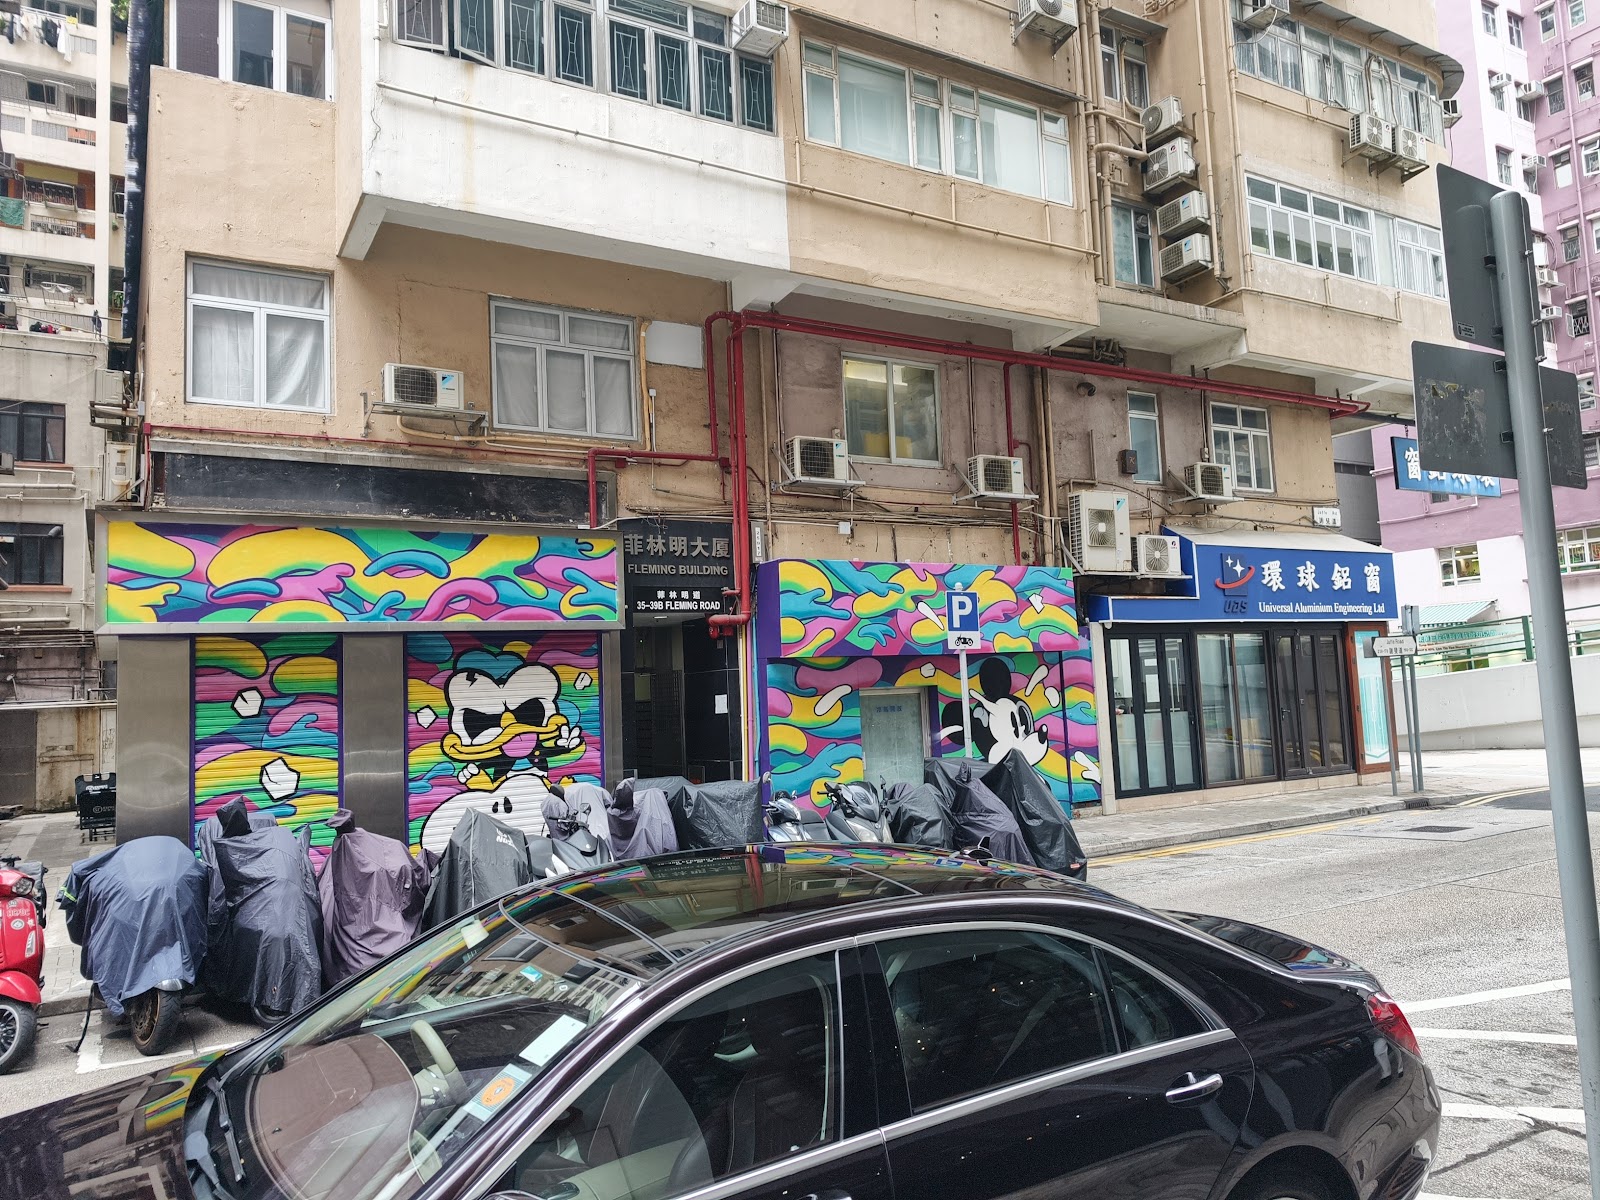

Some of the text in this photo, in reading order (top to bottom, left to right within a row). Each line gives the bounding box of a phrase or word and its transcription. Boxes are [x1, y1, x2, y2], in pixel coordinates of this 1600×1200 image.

[624, 534, 730, 558] 菲林明大厦
[628, 564, 728, 575] FLEMING BUILDING
[1261, 560, 1381, 594] 環球鋁窗
[657, 590, 701, 600] 菲林明道
[666, 601, 698, 610] FLEMING
[700, 601, 720, 610] ROAD
[951, 595, 973, 628] P
[1259, 602, 1385, 616] Universal Aluminium Engineering Ltd
